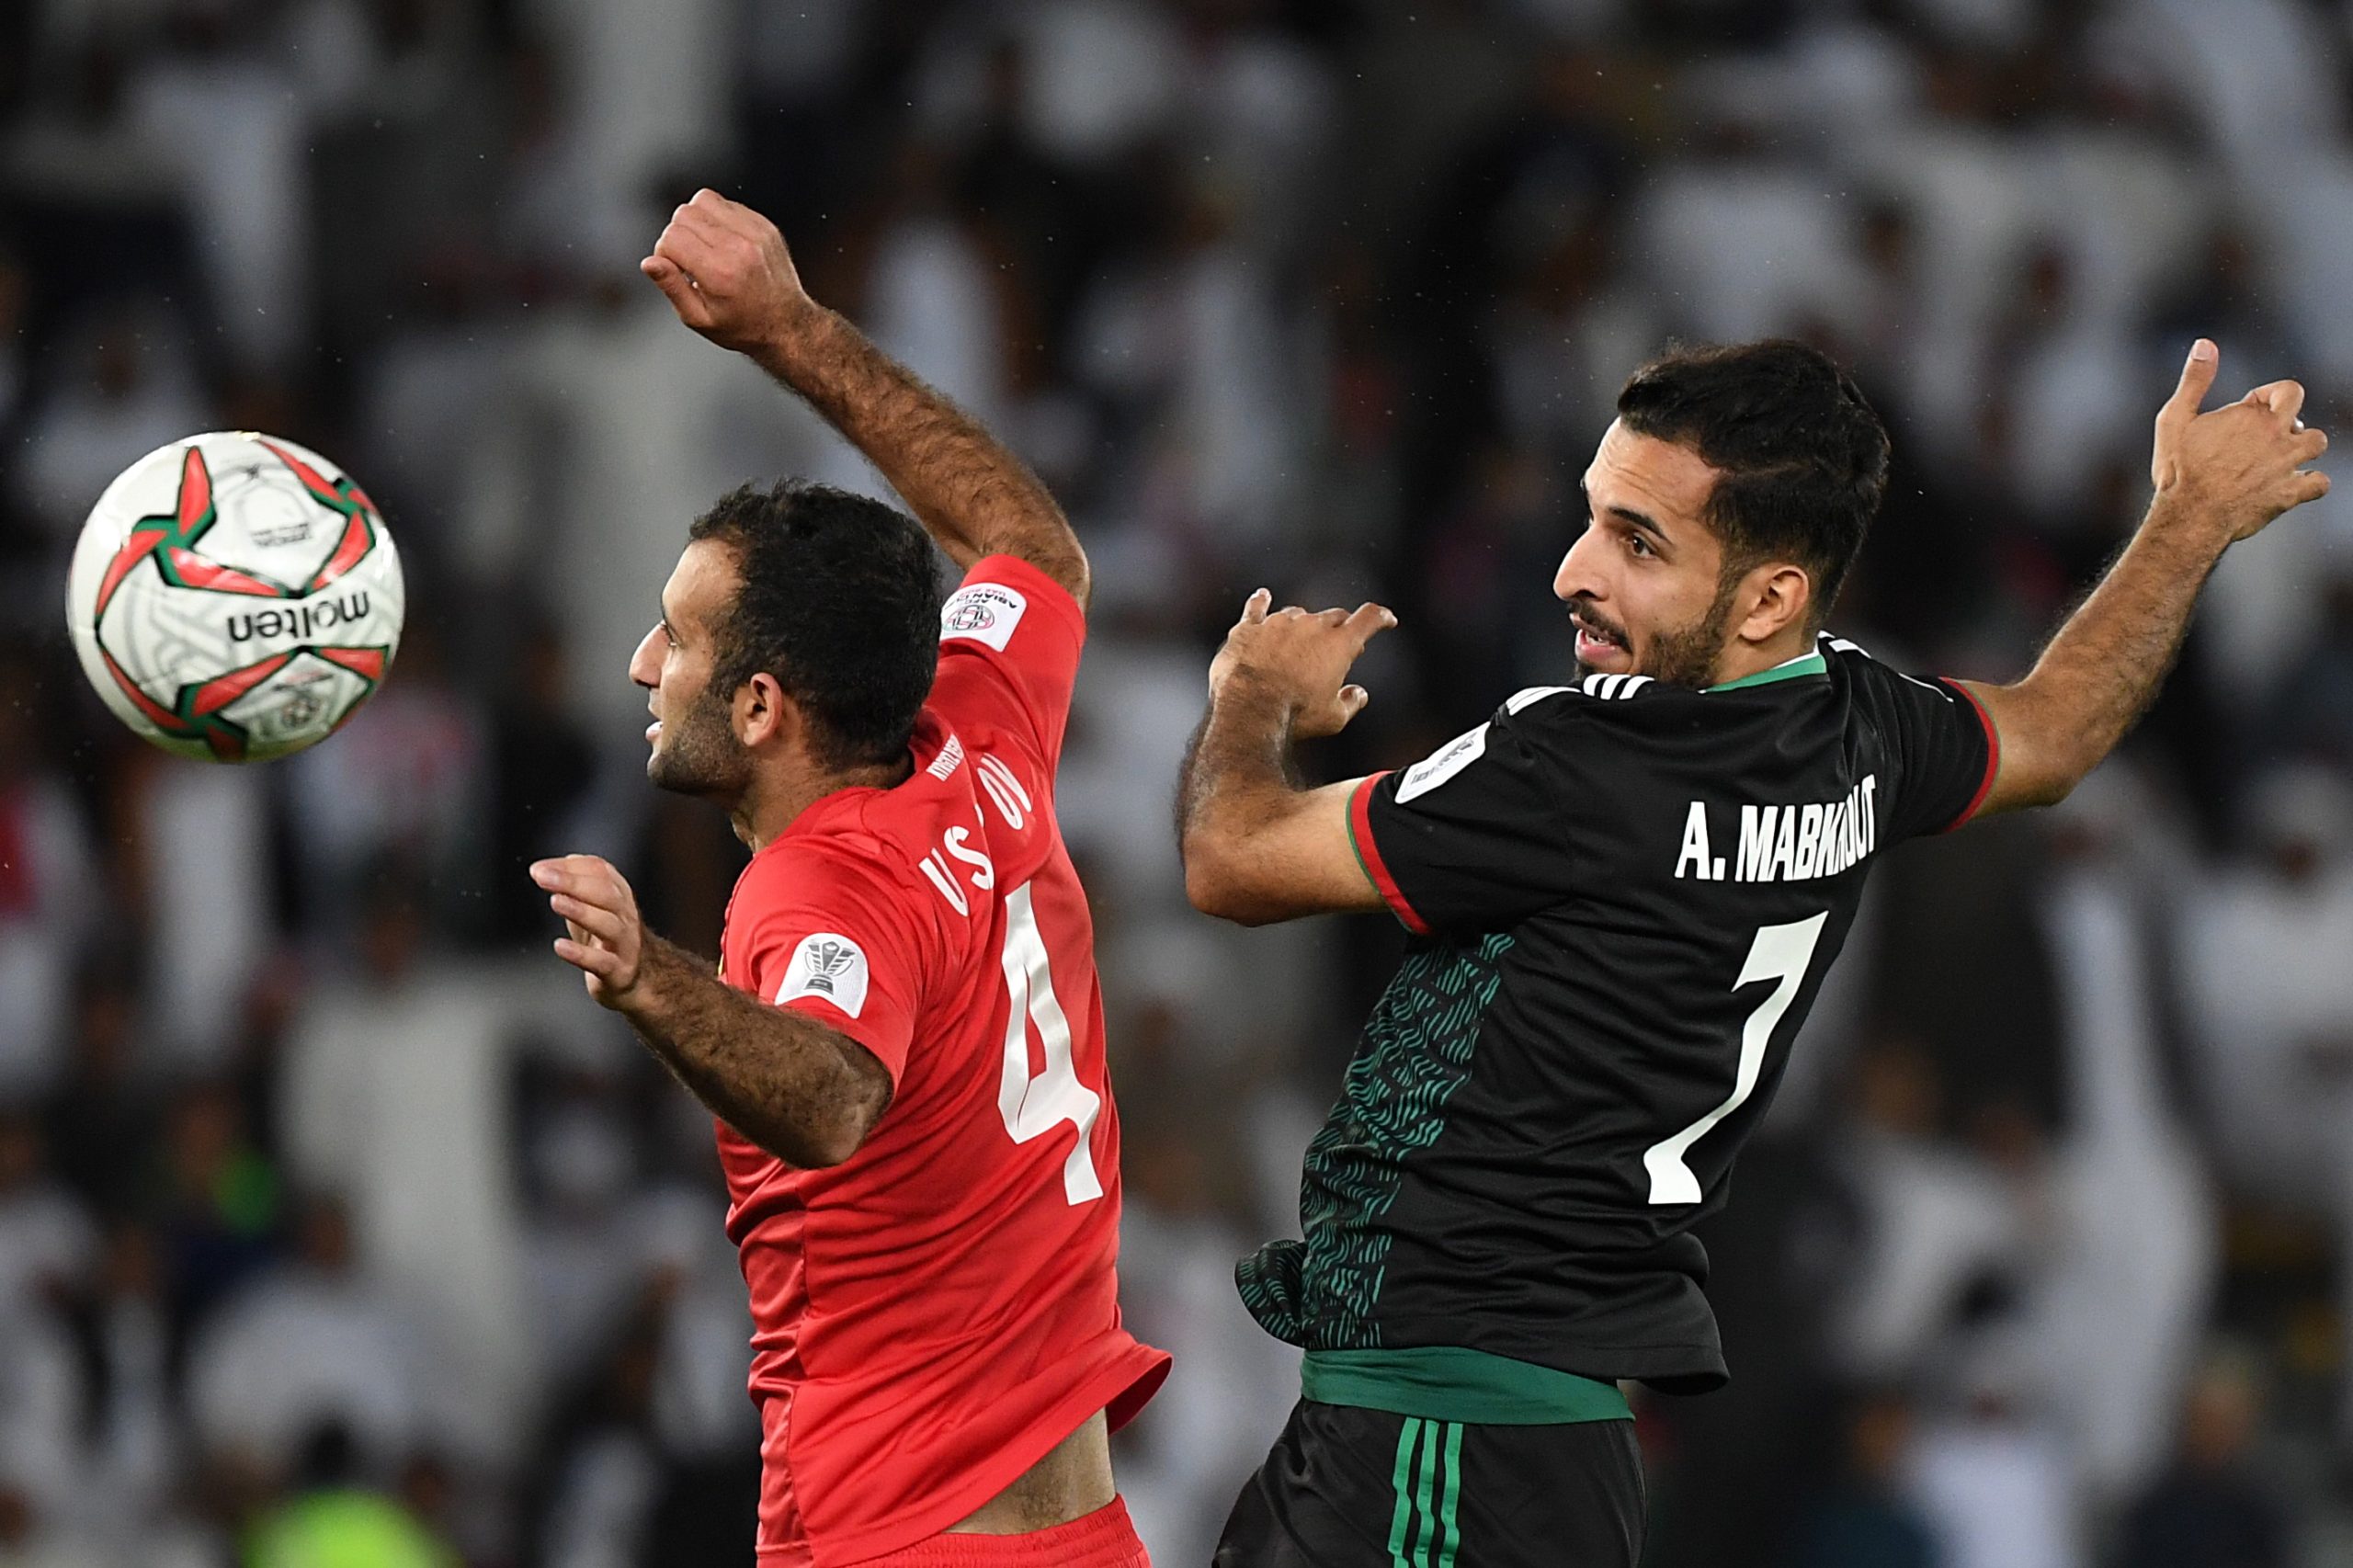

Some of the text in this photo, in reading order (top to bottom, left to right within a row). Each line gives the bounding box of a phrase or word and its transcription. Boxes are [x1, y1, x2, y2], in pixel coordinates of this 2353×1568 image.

[227, 591, 370, 642] molten
[1674, 801, 1726, 881] A.
[997, 880, 1104, 1206] 4
[1643, 910, 1829, 1204] 7
